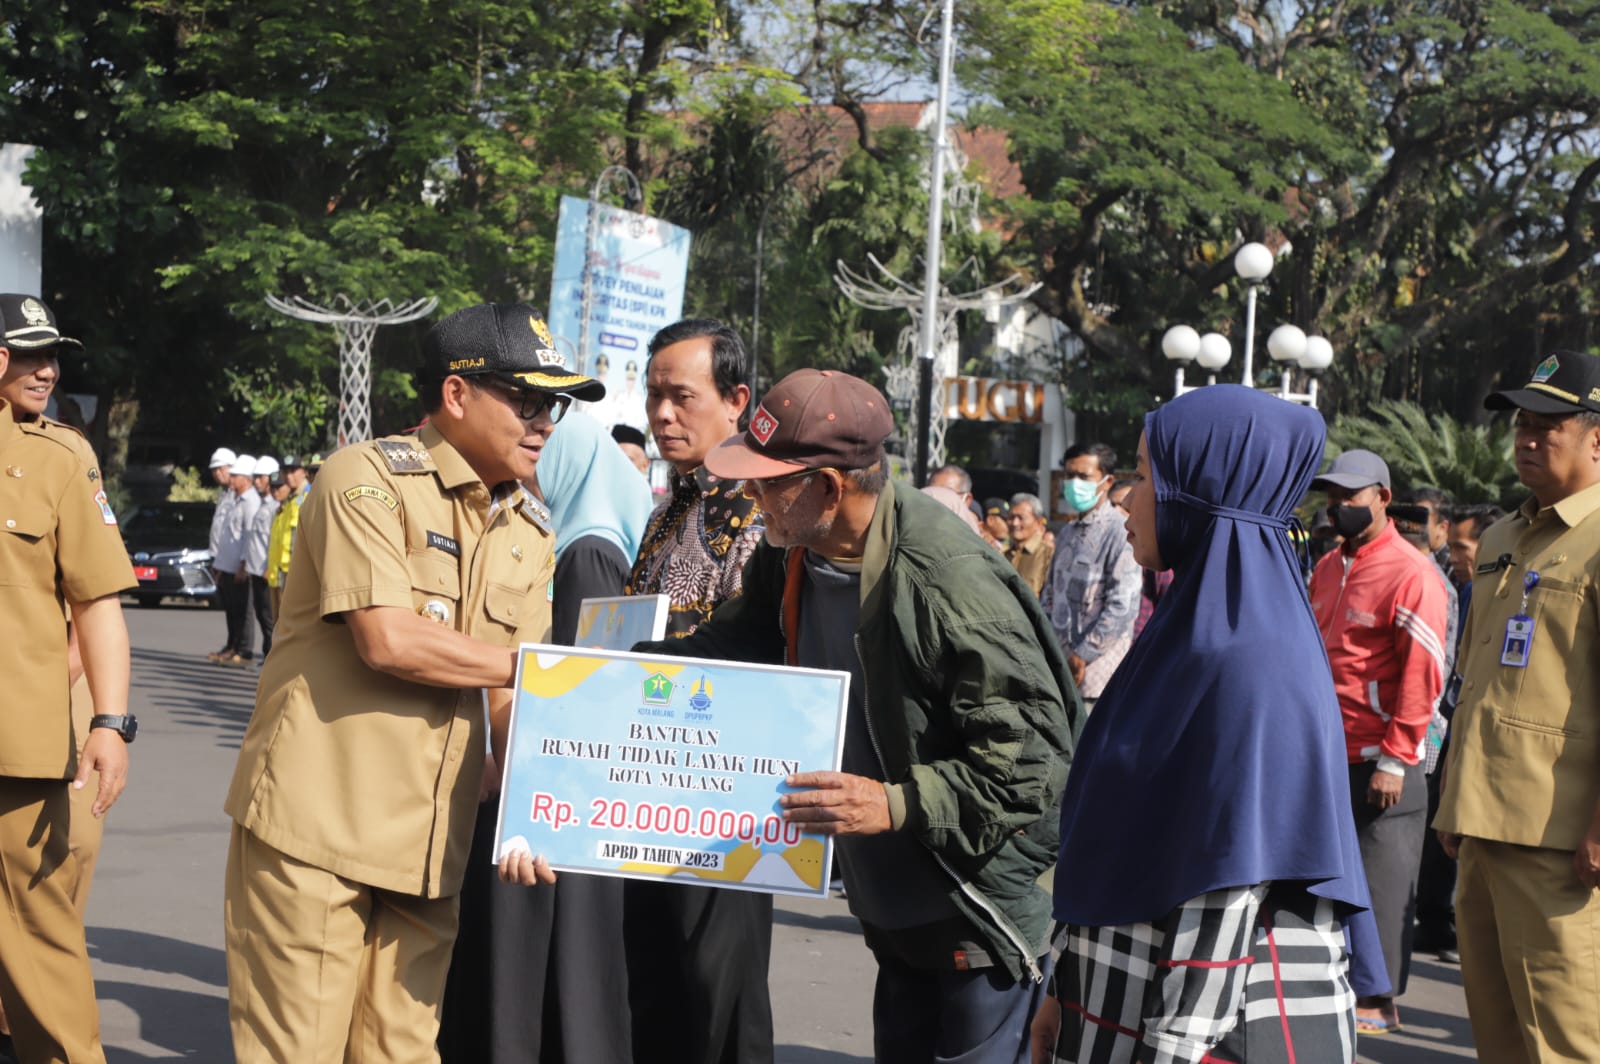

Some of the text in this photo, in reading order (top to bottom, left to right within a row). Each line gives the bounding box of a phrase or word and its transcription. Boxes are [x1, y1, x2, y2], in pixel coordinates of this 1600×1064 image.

[449, 357, 485, 370] SUTIAJI
[433, 535, 457, 550] SUTIAJI
[638, 708, 675, 718] KOTA MALANG
[629, 723, 719, 746] BANTUAN
[541, 738, 800, 776] RUMAH TIDAK LAYAK HUNI
[609, 767, 733, 792] KOTA MALANG
[532, 794, 801, 846] Rp. 20.000.000,00
[602, 843, 719, 868] APBD TAHUN 2023
